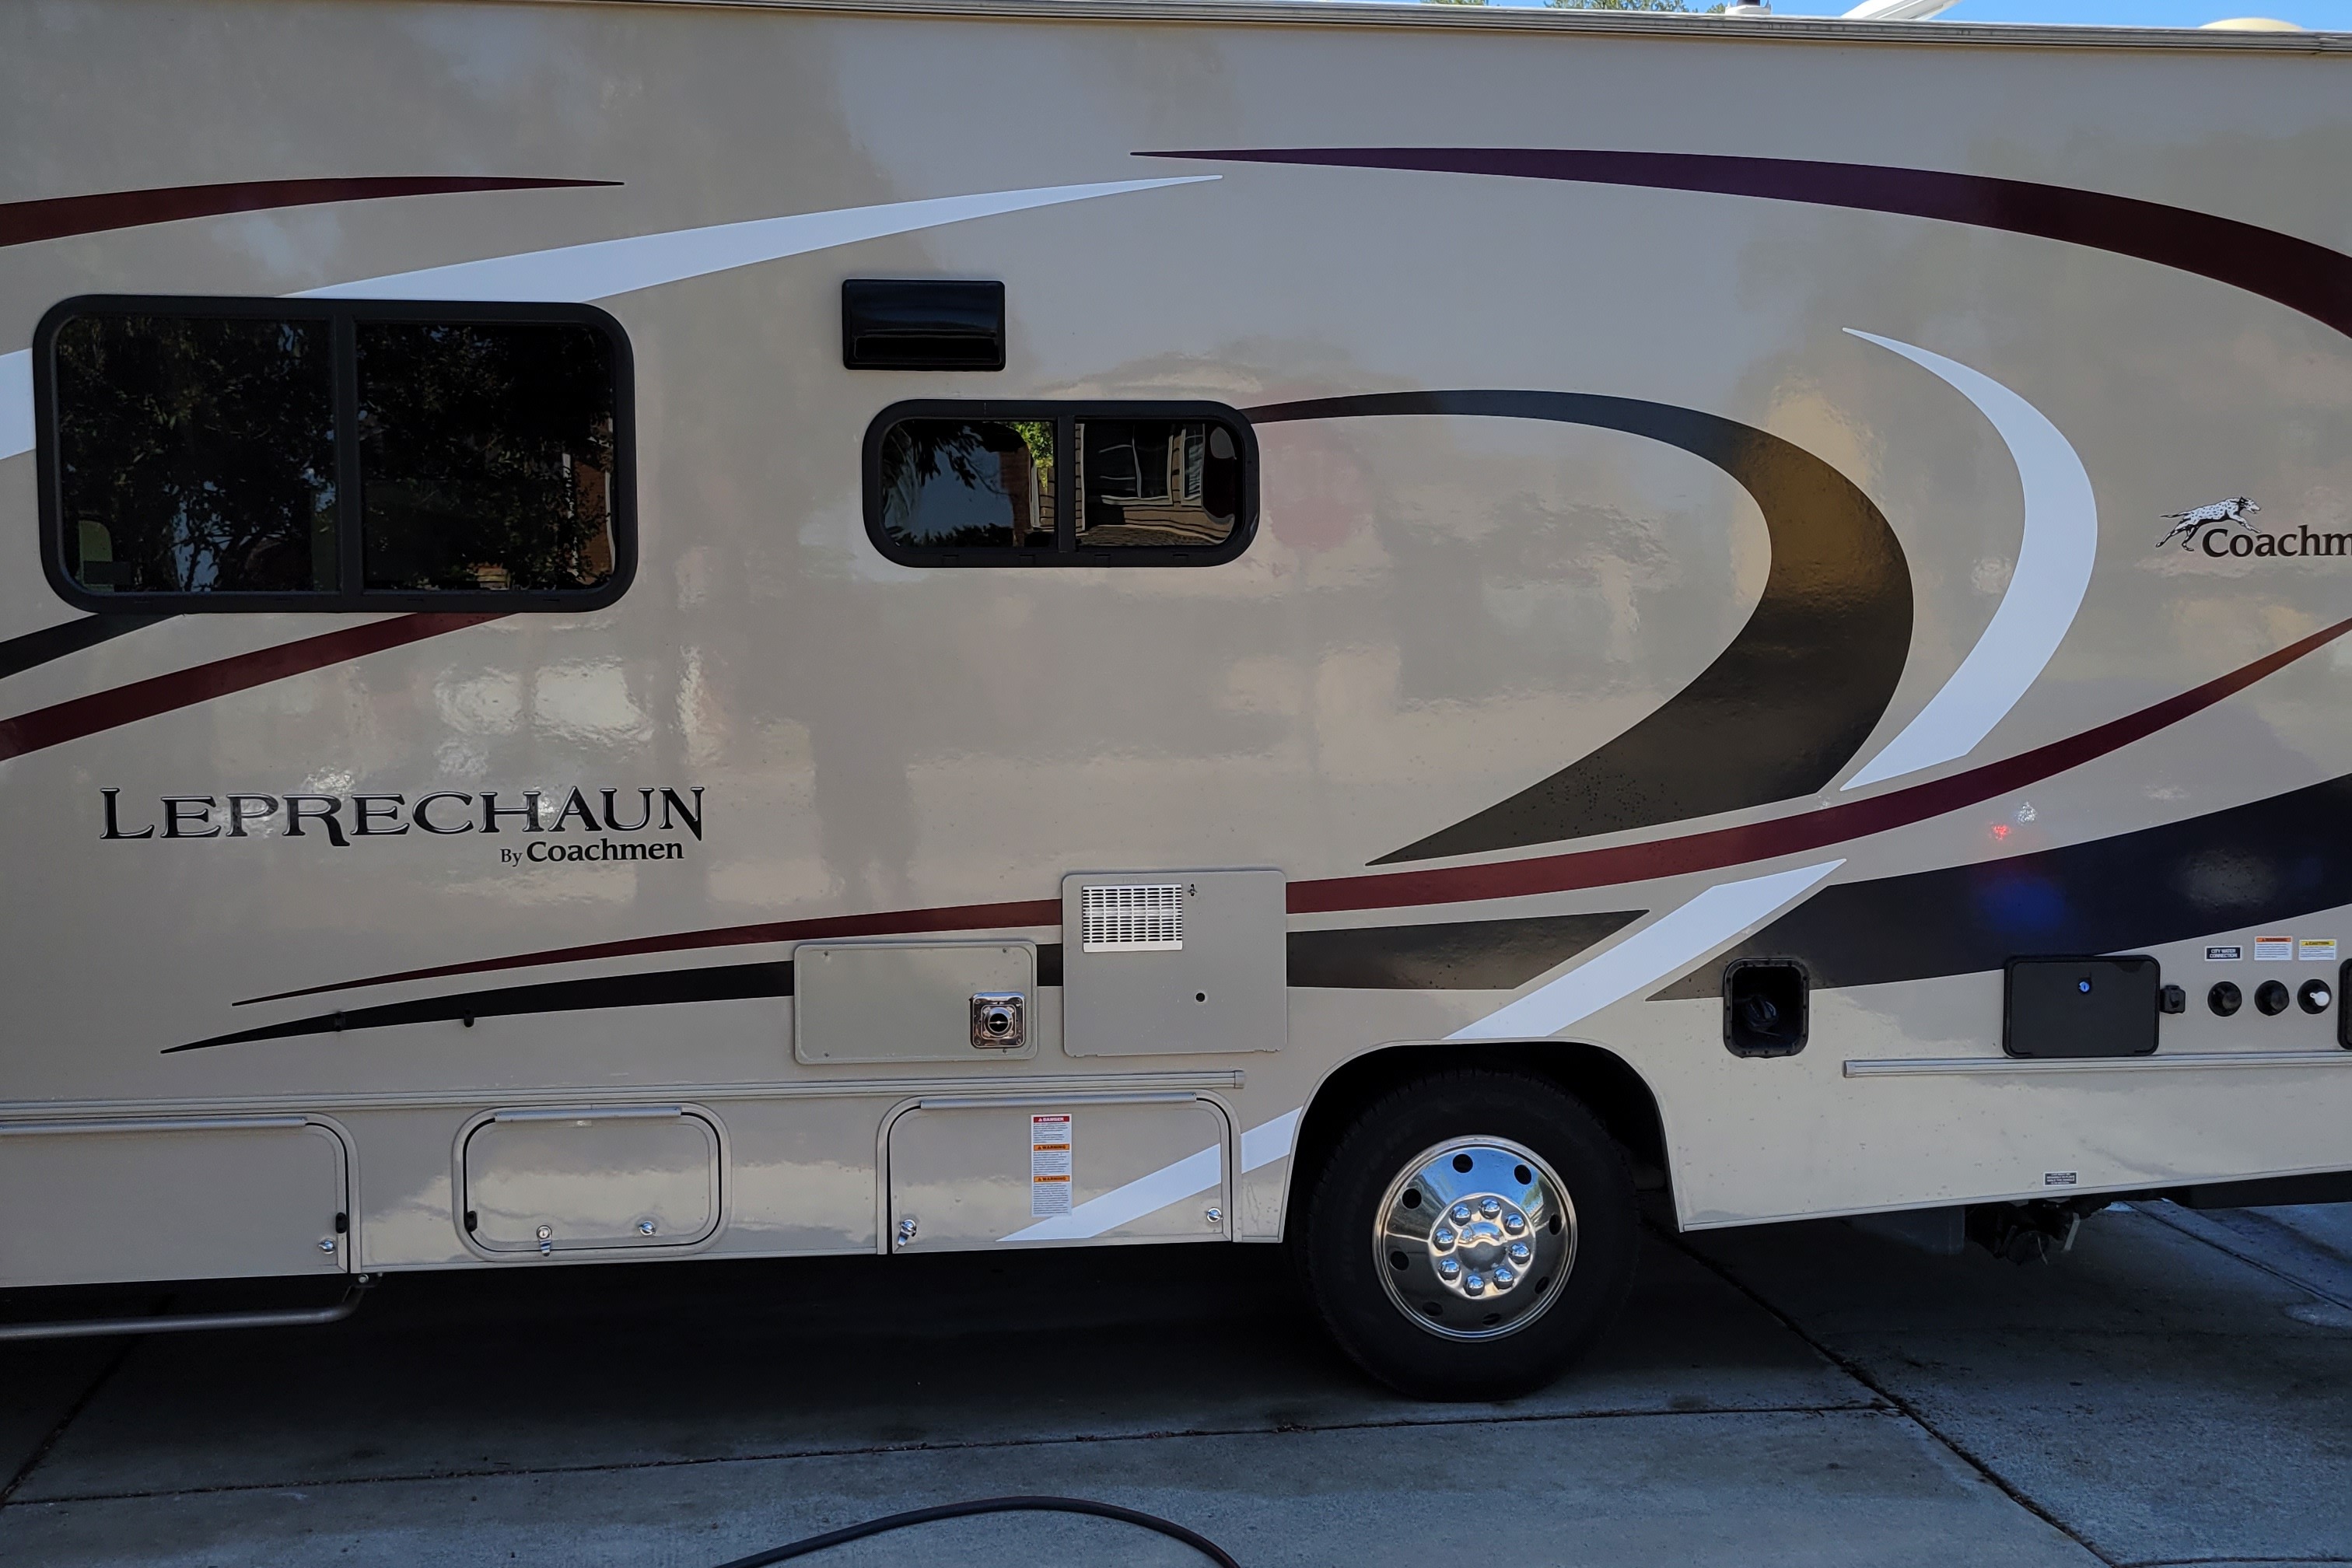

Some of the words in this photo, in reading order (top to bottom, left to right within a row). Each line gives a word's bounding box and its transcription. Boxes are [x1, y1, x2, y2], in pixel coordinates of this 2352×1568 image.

[100, 786, 705, 847] LEPRECHAUN
[500, 848, 523, 867] By
[527, 838, 684, 863] Coachmen
